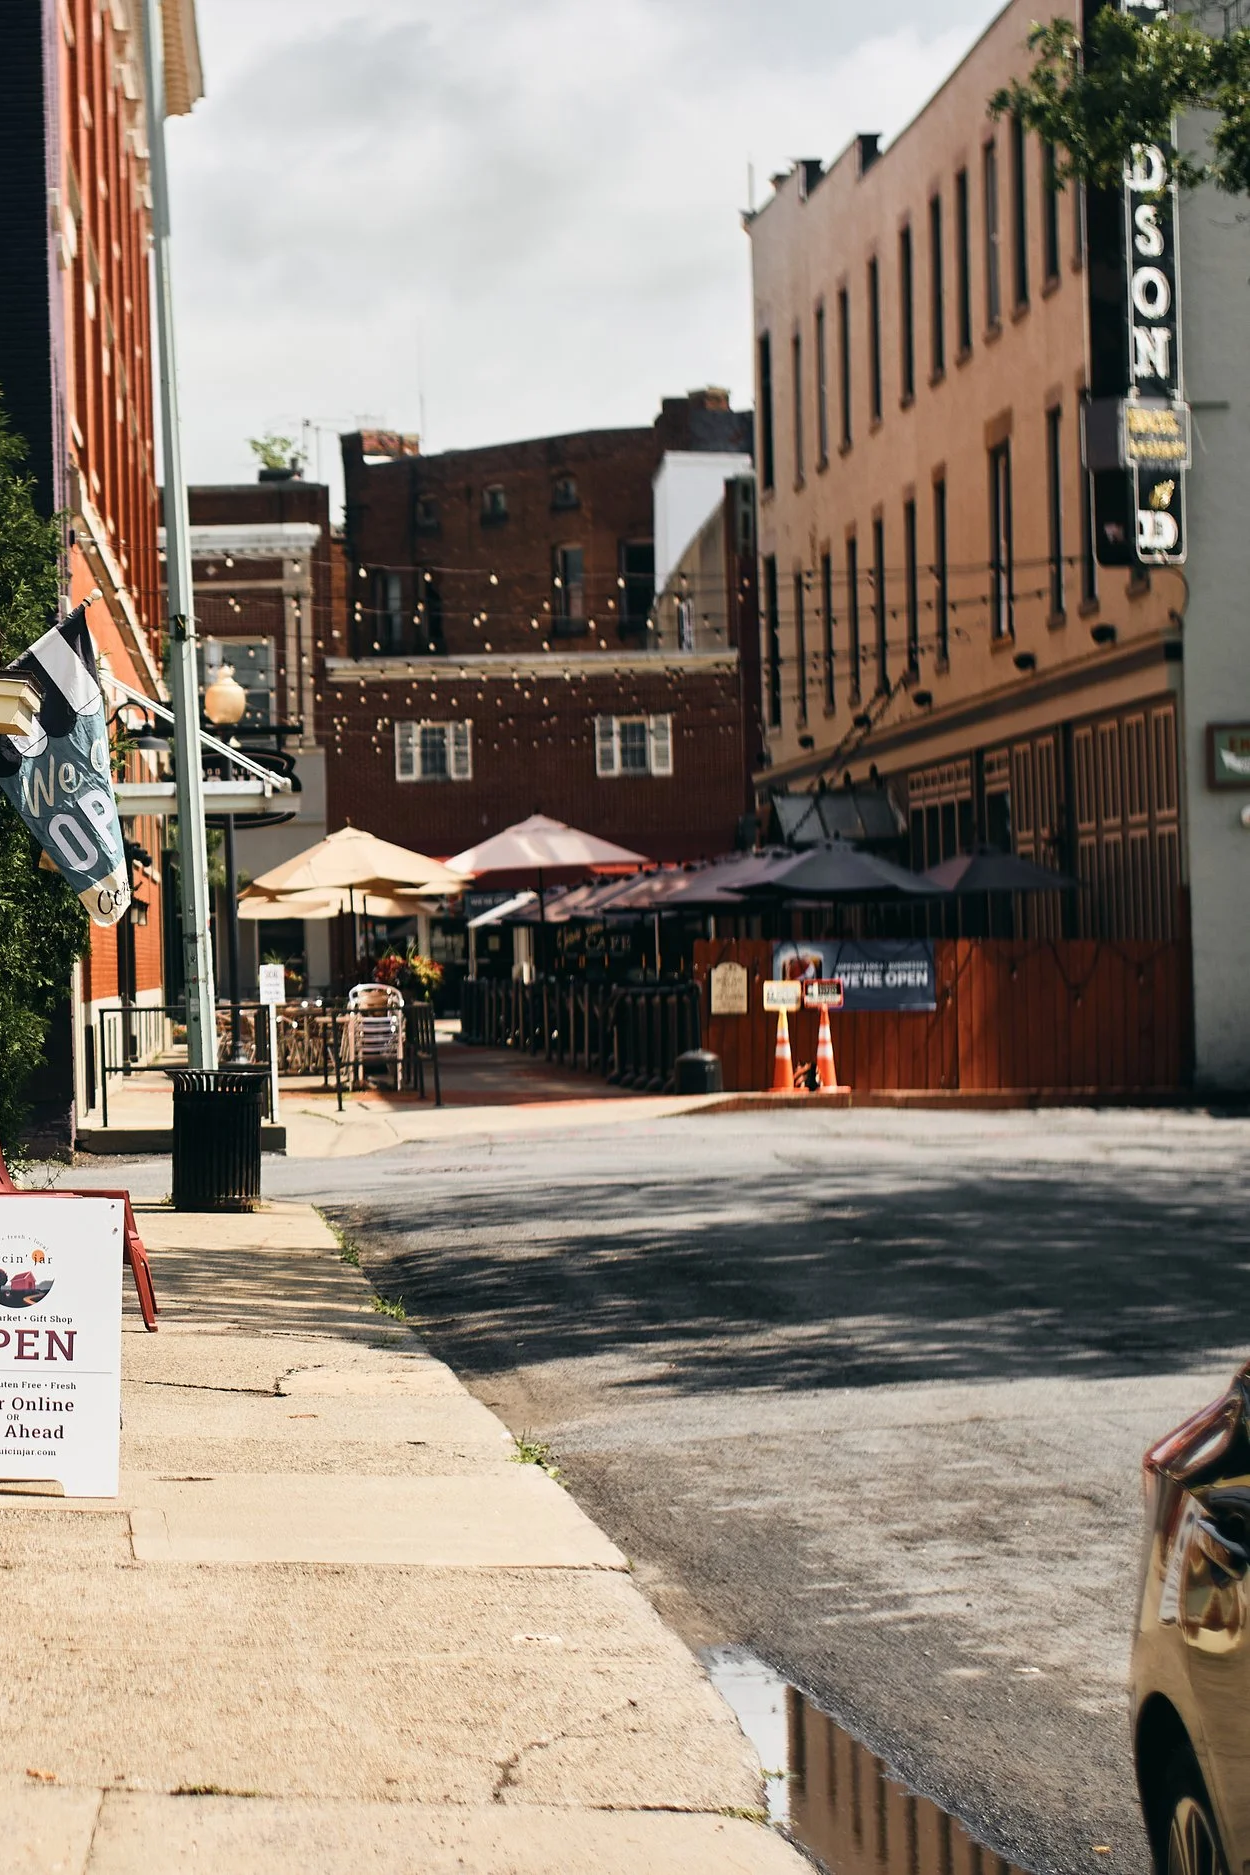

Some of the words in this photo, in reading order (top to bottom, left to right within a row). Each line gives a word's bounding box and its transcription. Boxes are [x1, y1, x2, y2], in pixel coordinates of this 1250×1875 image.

[22, 753, 83, 818] We
[834, 970, 882, 988] WE'RE
[885, 969, 928, 988] OPEN
[33, 1254, 53, 1266] jar
[29, 1315, 47, 1323] Gift
[49, 1315, 73, 1325] Shop
[21, 1382, 42, 1390] Free
[50, 1382, 77, 1390] Fresh
[11, 1396, 75, 1412] Online
[6, 1413, 20, 1421] OR
[3, 1424, 64, 1439] Ahead
